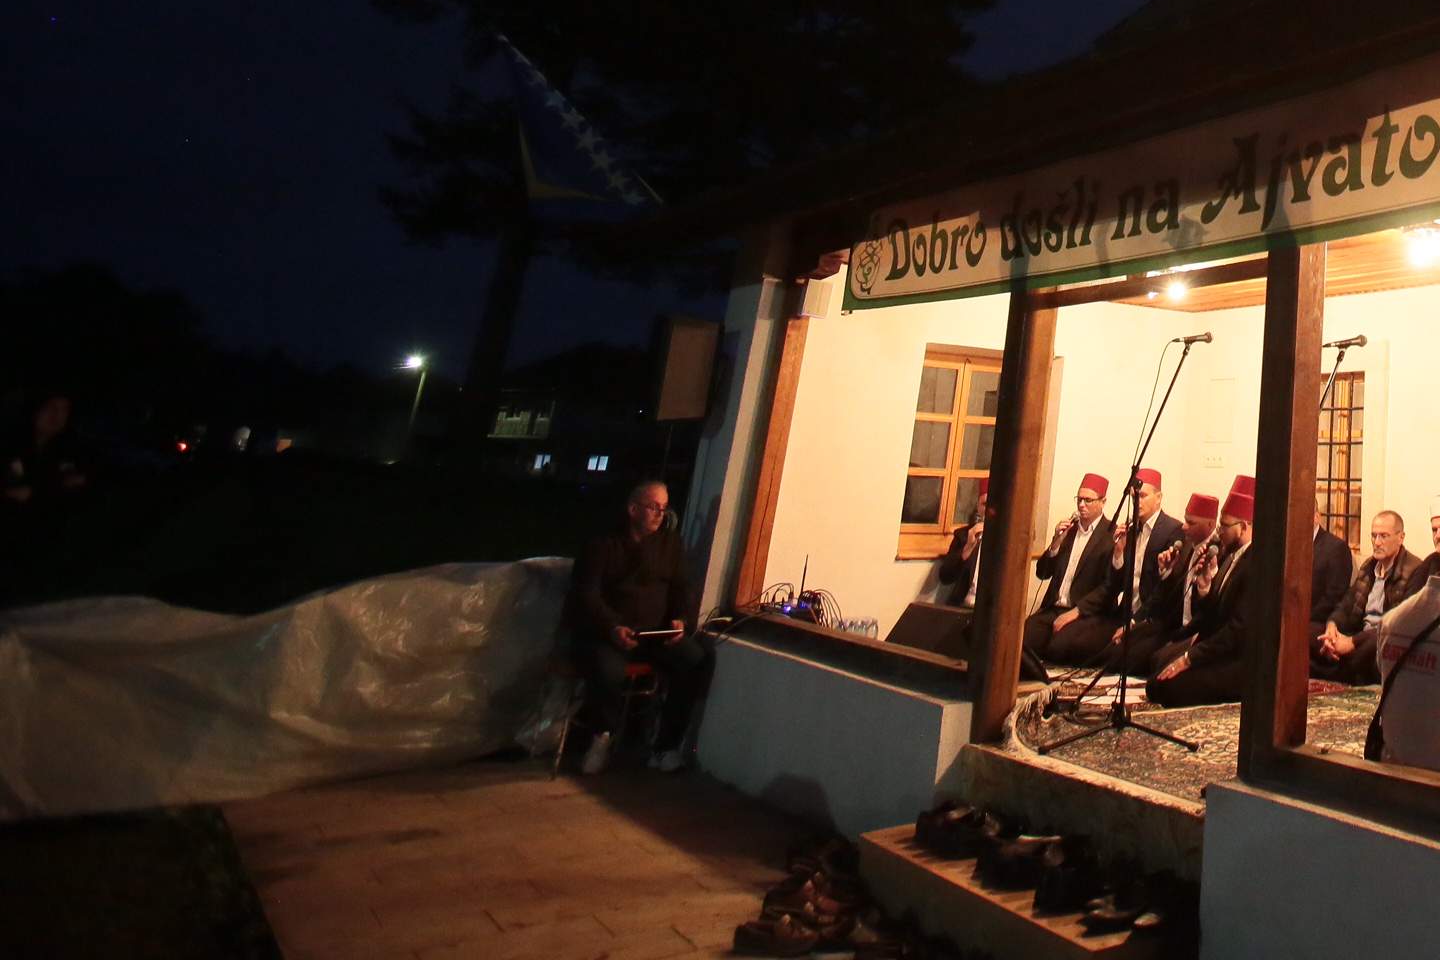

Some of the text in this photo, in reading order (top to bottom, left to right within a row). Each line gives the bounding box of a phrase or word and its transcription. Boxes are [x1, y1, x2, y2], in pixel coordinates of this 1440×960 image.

[884, 210, 988, 282] Dobro
[999, 174, 1100, 262] došli
[1110, 177, 1182, 242] na
